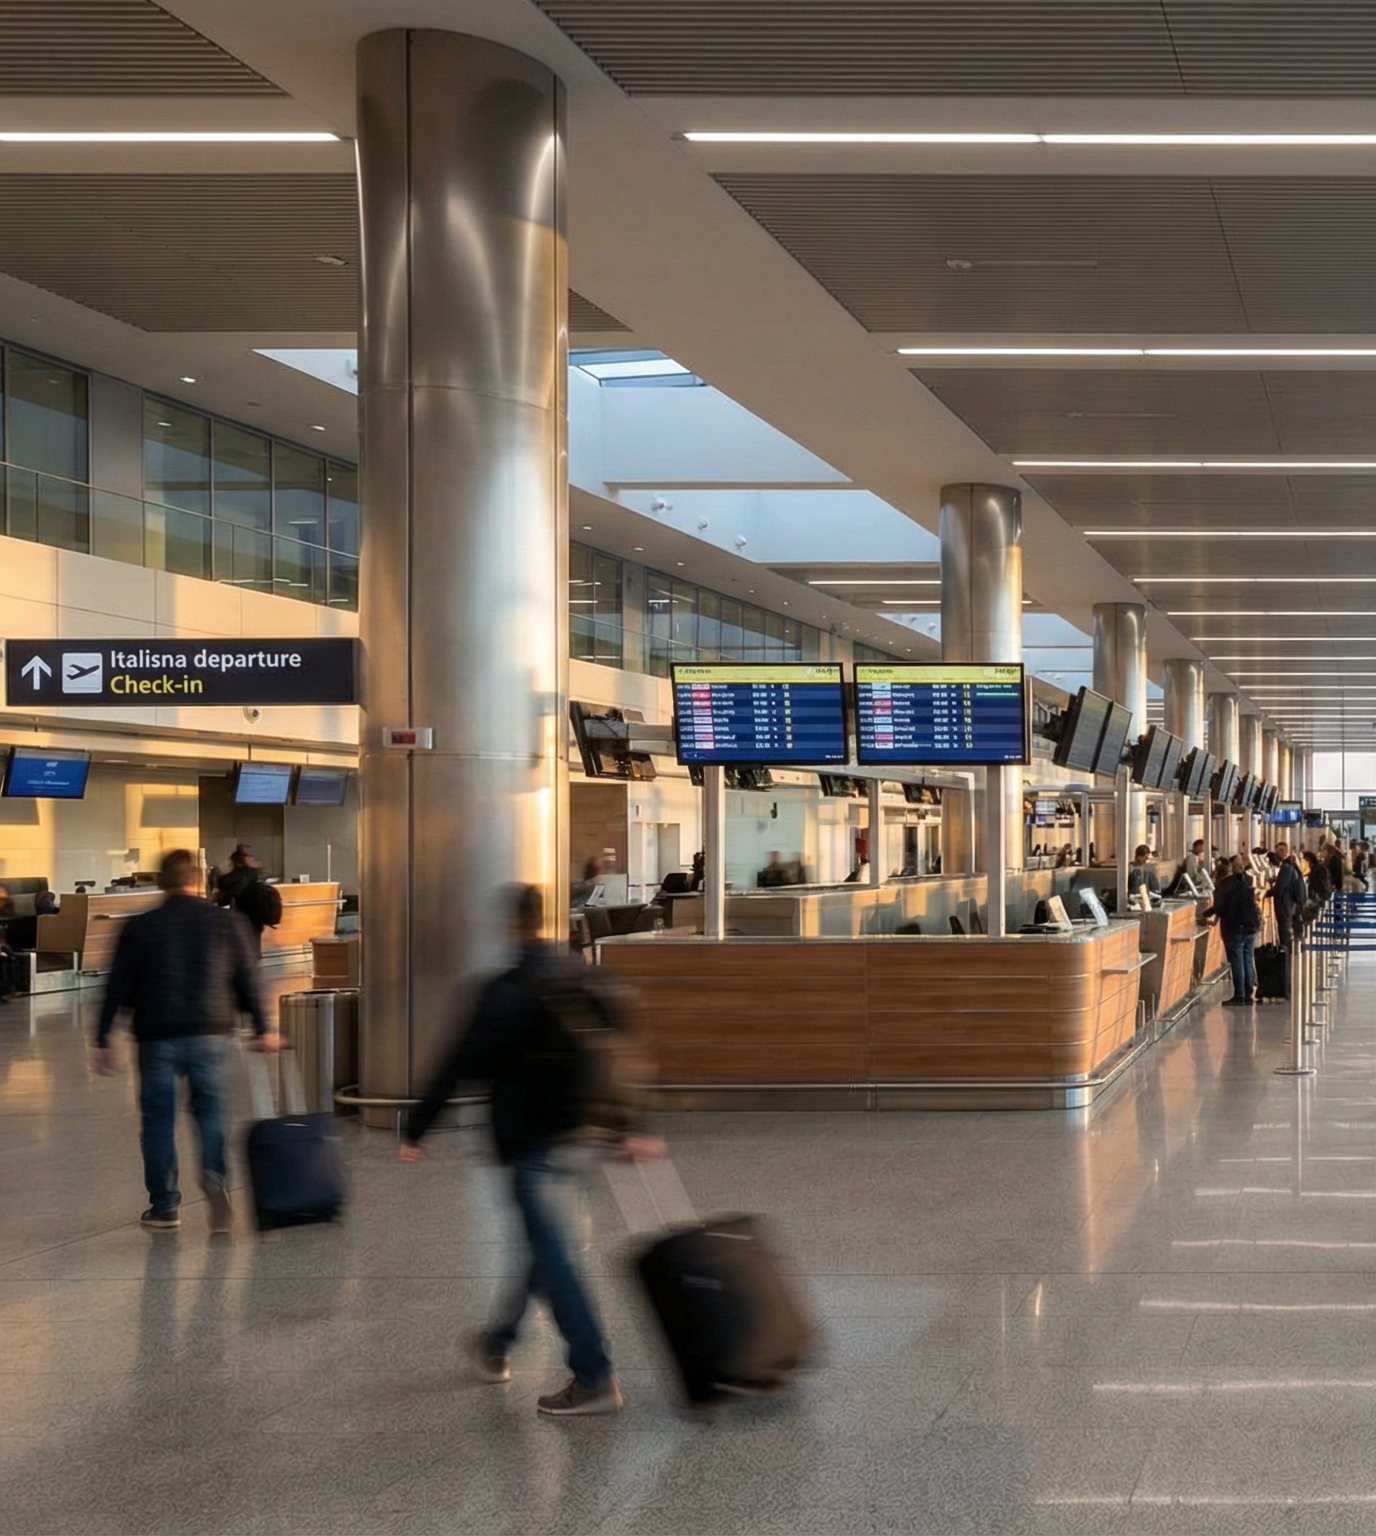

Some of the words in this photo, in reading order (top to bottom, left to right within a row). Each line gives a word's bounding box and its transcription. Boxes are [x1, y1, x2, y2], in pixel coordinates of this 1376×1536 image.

[110, 649, 187, 668] Italisna
[193, 648, 302, 672] departure
[110, 674, 203, 694] Check-in
